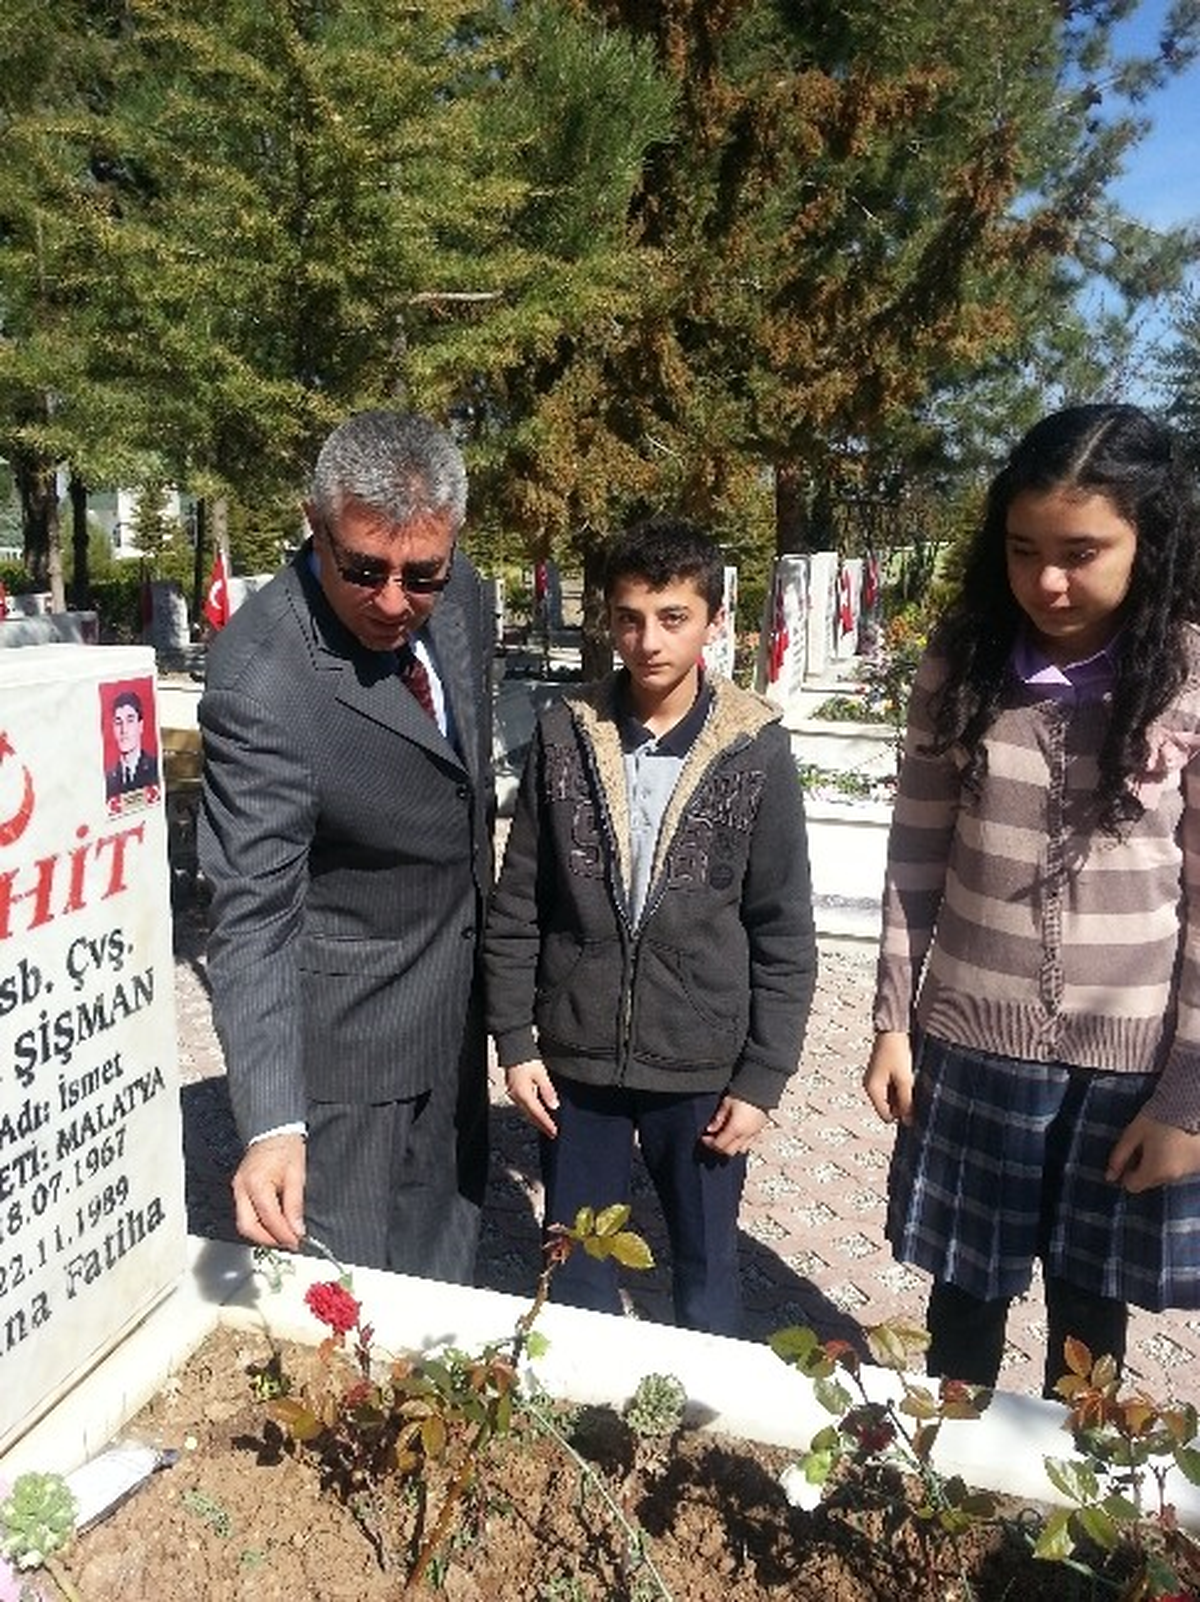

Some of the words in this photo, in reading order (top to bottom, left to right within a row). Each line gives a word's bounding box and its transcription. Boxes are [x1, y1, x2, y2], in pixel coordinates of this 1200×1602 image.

[65, 928, 134, 991] Çvş.
[14, 966, 155, 1088] ŞİŞMAN
[56, 1066, 166, 1162] MALATYA
[0, 1124, 127, 1245] 8.07.1967
[63, 1197, 165, 1300] Fatiha
